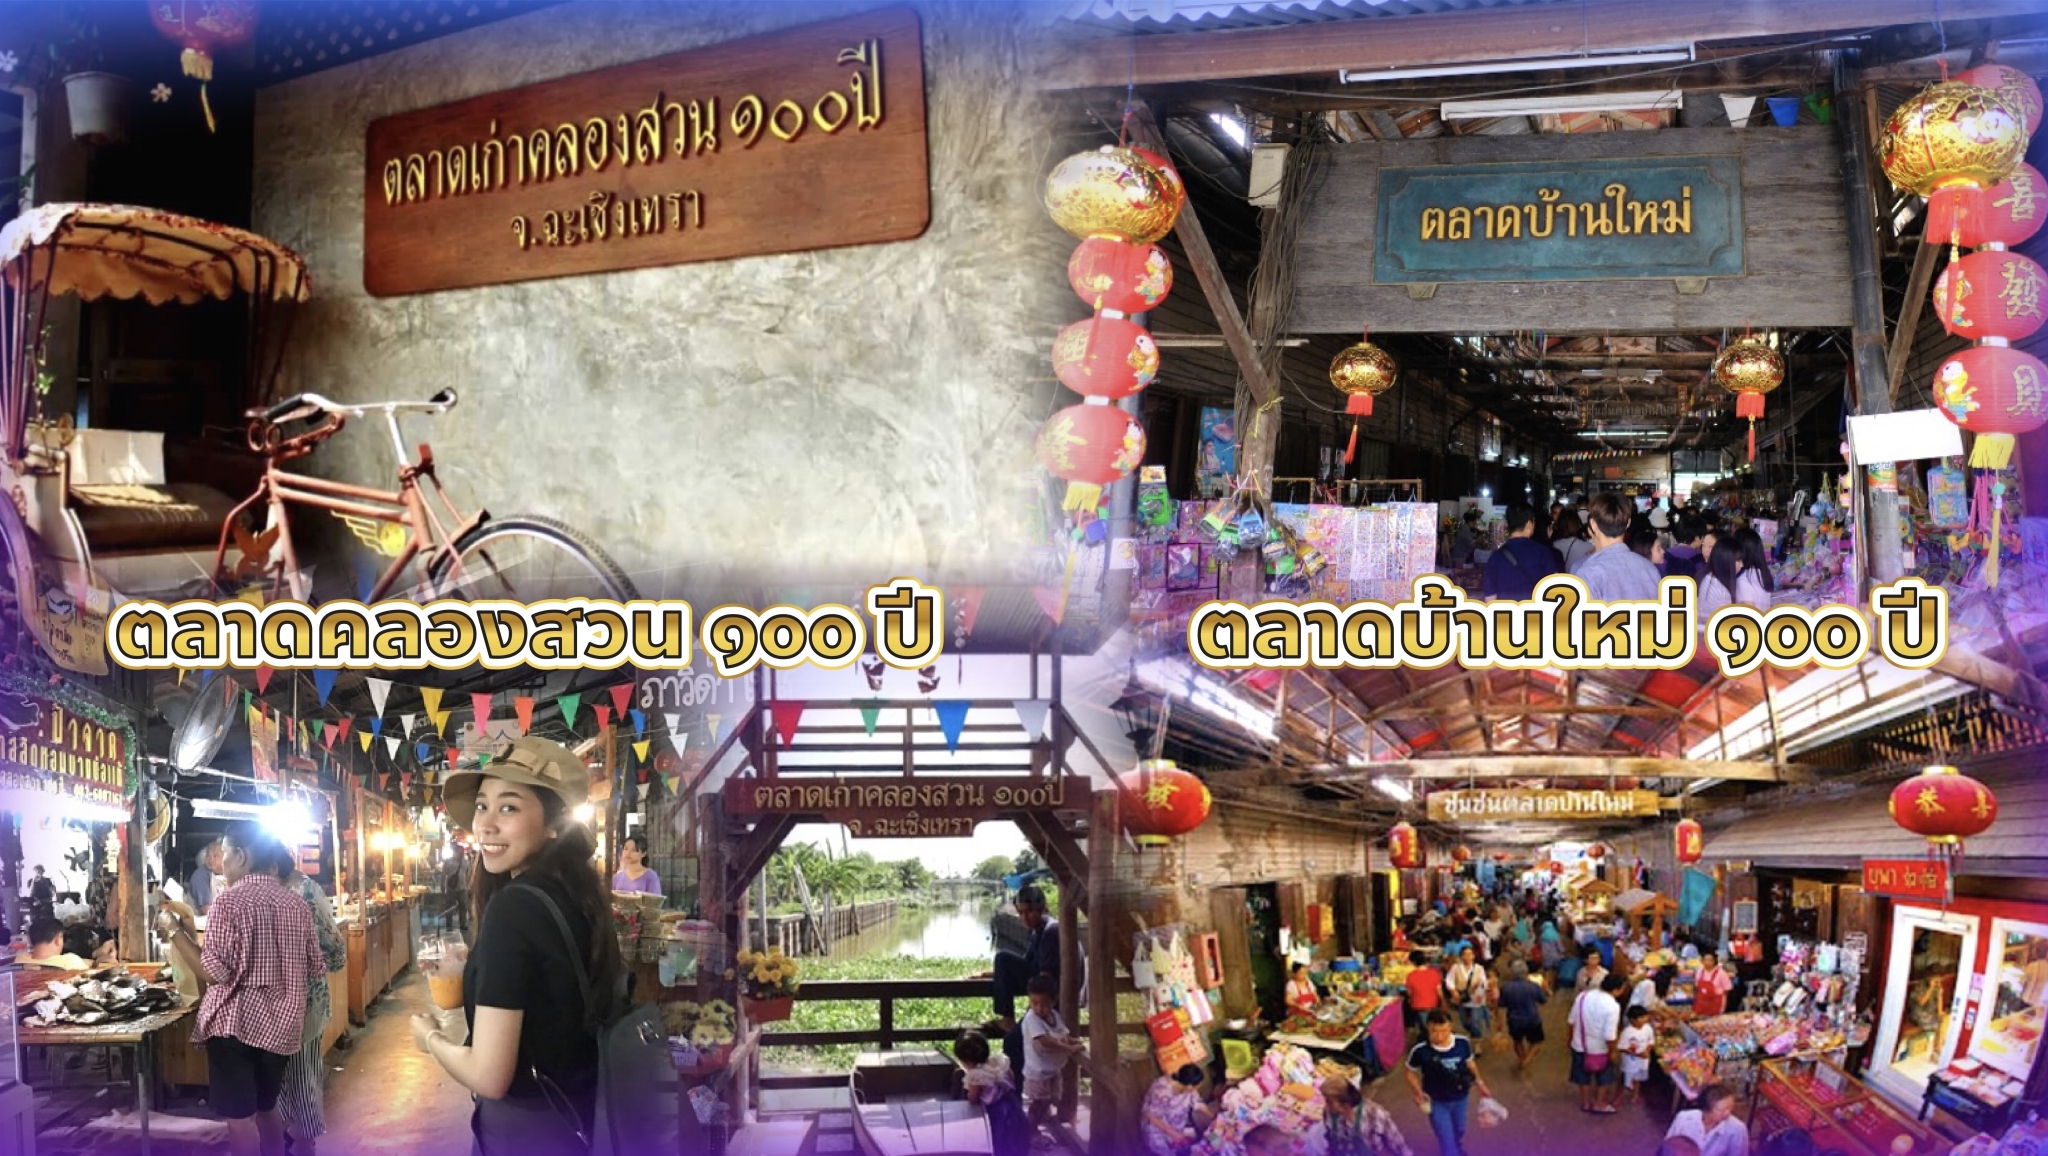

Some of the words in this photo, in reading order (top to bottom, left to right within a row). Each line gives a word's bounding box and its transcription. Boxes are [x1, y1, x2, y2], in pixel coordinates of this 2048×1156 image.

[383, 93, 719, 206] ตลาดเก่าคลองสวน
[731, 38, 886, 149] ๑๐๐ปี
[511, 190, 706, 250] จ.ฉะเชิงเทรา
[1420, 183, 1692, 242] ตลาดบ้านใหม่
[754, 775, 984, 808] ตลาดเก่าคลองสวน
[993, 774, 1064, 806] ๑๐๐ปี
[850, 811, 974, 837] จ.ฉะเชิงเทรา
